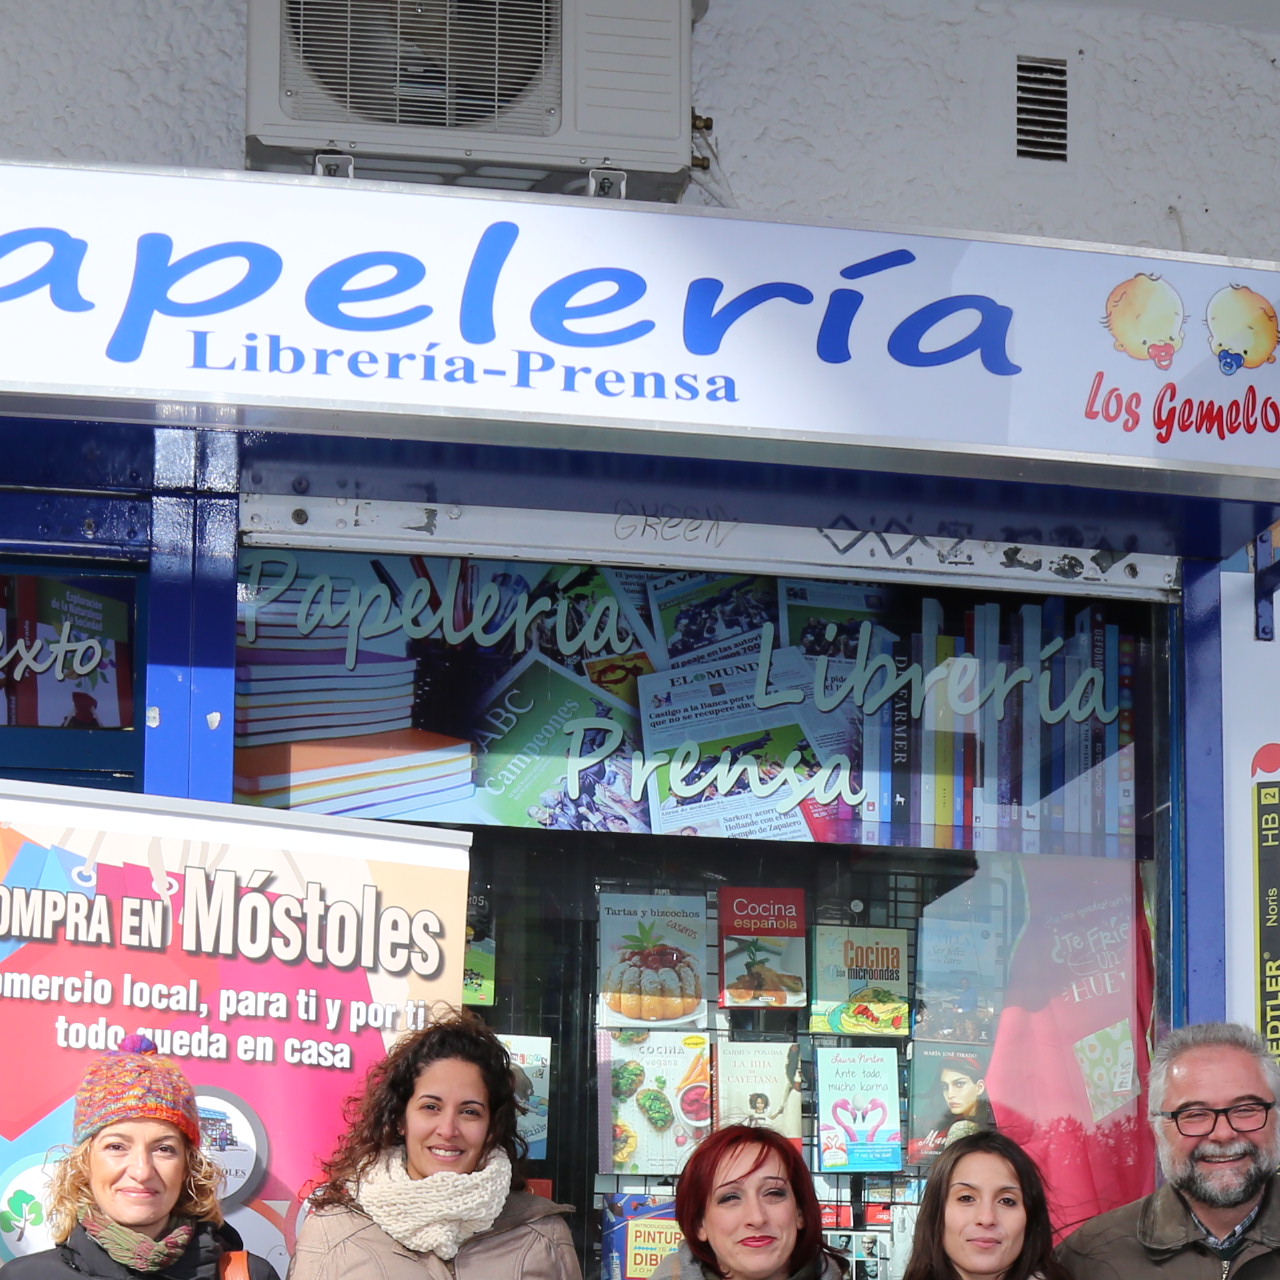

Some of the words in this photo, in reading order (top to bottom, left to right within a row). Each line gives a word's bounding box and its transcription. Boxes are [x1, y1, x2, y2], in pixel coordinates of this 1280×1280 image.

[186, 329, 740, 403] Librería-Prensa
[1084, 371, 1142, 434] Los
[238, 549, 634, 671] Papelería
[754, 619, 1120, 726] Librería
[474, 689, 534, 755] ABC
[484, 698, 581, 797] Campeones
[562, 716, 868, 815] Prensa
[1264, 790, 1276, 800] 2
[723, 812, 753, 826] Sarkozy
[725, 819, 759, 832] Hollande
[768, 819, 802, 833] Zapatero
[1261, 812, 1280, 847] HB
[604, 907, 639, 916] Tartas
[641, 909, 647, 918] y
[650, 908, 700, 919] bizcochos
[733, 898, 797, 917] Cocina
[1265, 887, 1278, 927] Noris
[121, 892, 166, 950] EN
[182, 866, 443, 977] Móstoles
[666, 919, 699, 940] caseros
[734, 917, 798, 931] española
[843, 939, 900, 970] Cocina
[847, 968, 900, 981] microondas
[123, 972, 208, 1020] local,
[220, 986, 287, 1023] para
[296, 987, 317, 1023] ti
[325, 997, 341, 1031] y
[350, 998, 399, 1034] por
[55, 1015, 121, 1053] todo
[236, 1035, 275, 1063] en
[284, 1036, 352, 1070] casa
[638, 1045, 685, 1055] COCINA
[645, 1058, 678, 1069] vegana
[733, 1060, 746, 1068] LA
[750, 1060, 772, 1068] HIJA
[834, 1068, 856, 1079] Ante
[862, 1068, 882, 1079] todo,
[727, 1075, 779, 1084] CAYETANA
[828, 1082, 856, 1092] mucho
[860, 1081, 889, 1092] karma
